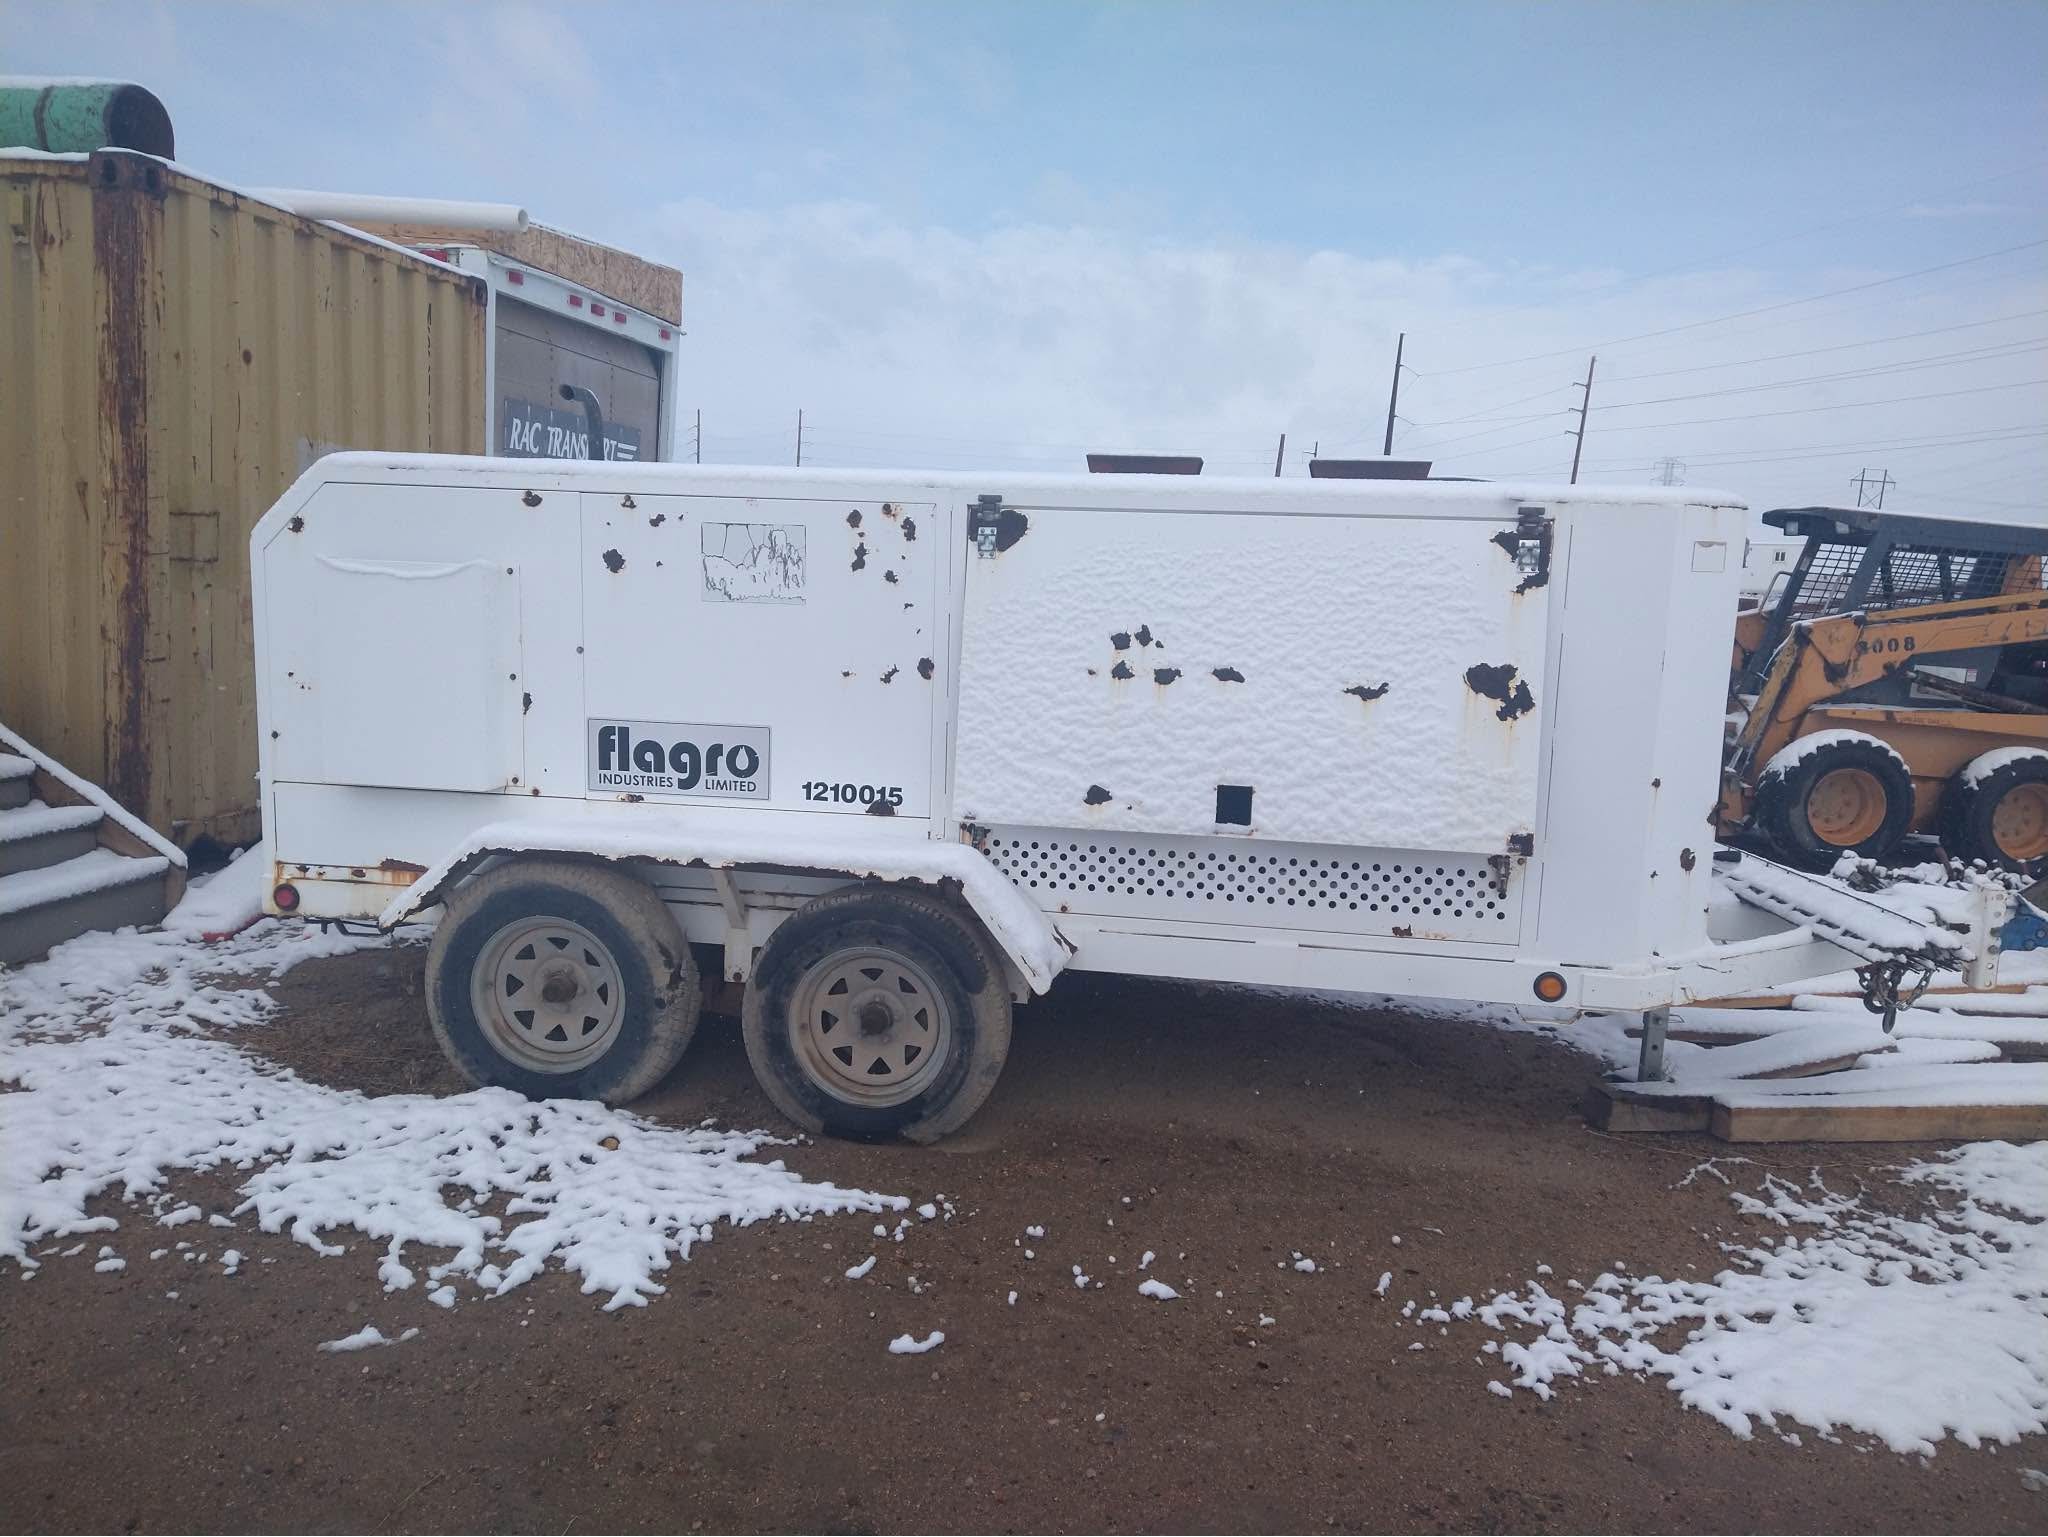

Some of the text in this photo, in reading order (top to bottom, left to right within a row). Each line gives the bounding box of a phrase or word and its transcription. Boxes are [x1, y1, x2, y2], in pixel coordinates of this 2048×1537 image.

[510, 417, 617, 460] RAC TRANSRT
[598, 725, 760, 790] flagro
[599, 773, 757, 792] INDUSTRIES LIMITED
[802, 781, 903, 806] 1210015
